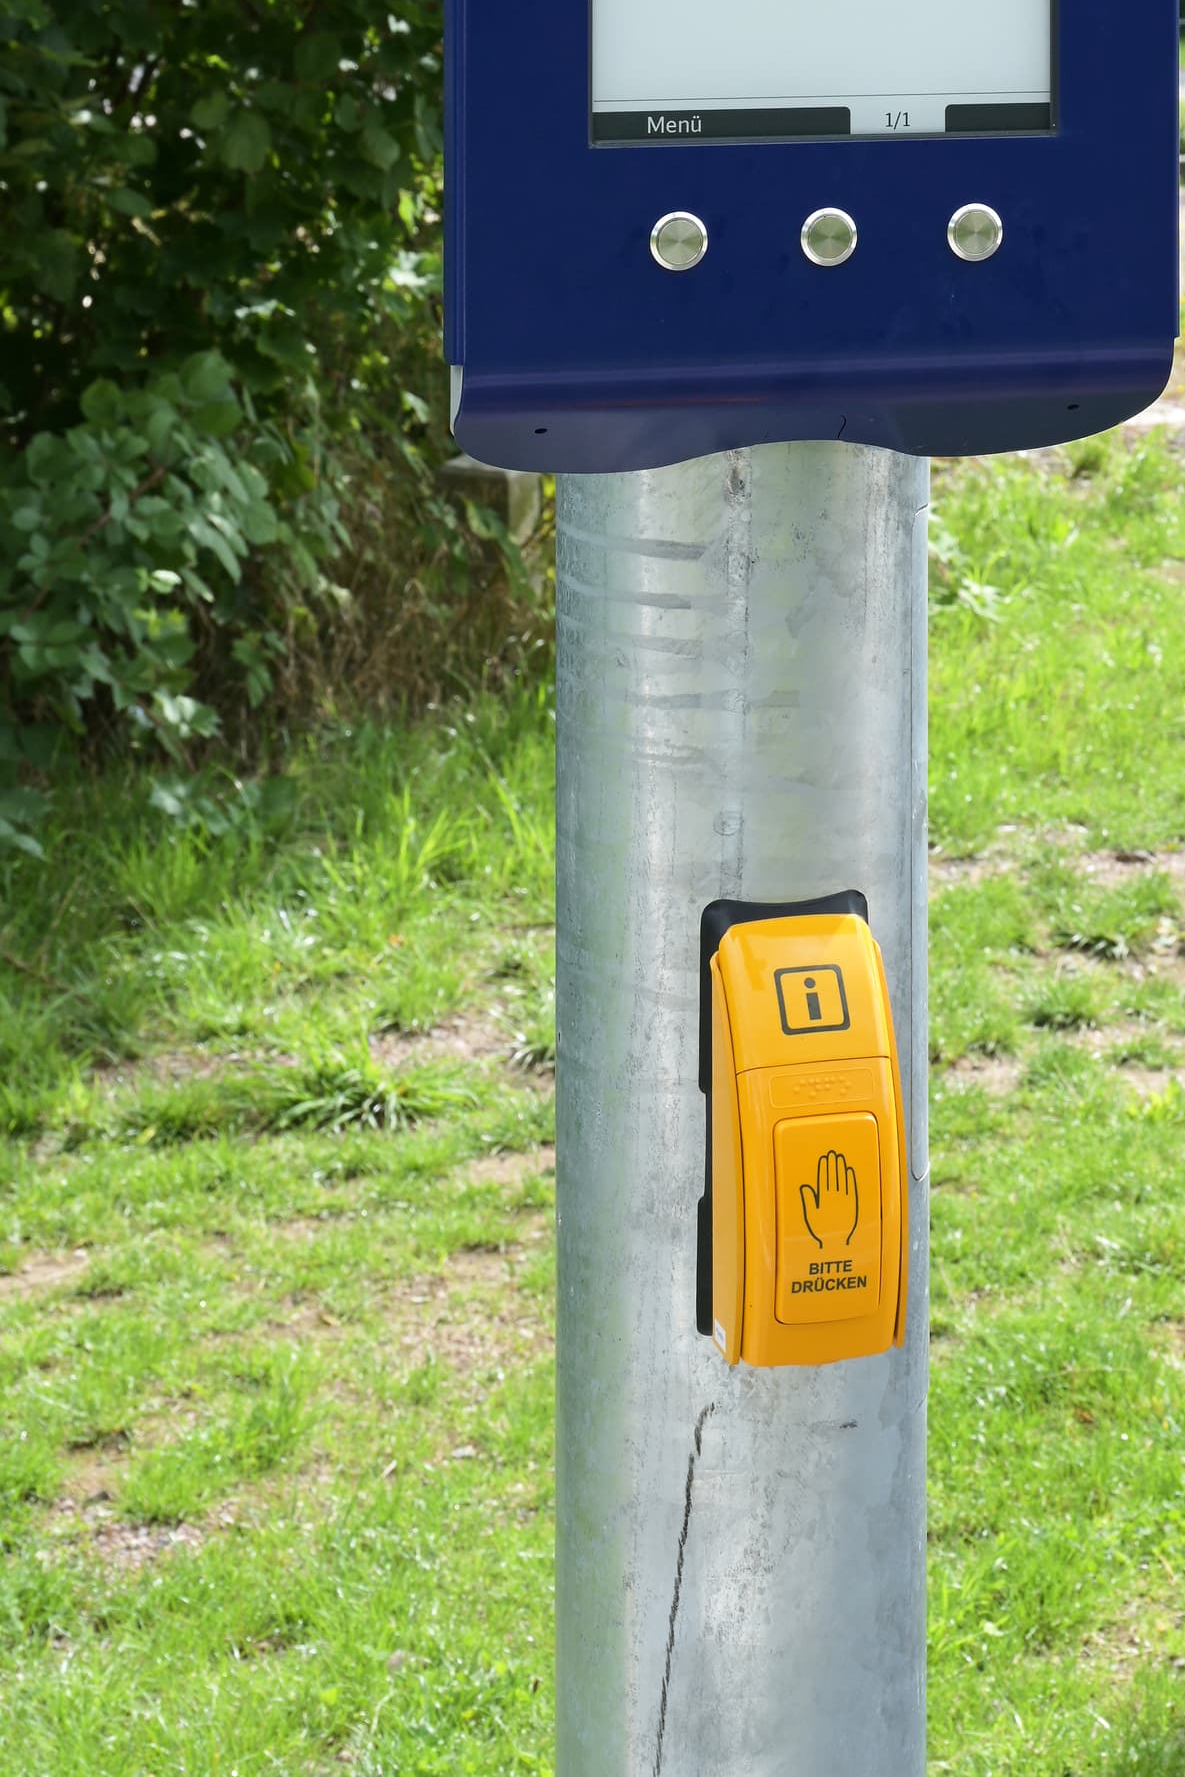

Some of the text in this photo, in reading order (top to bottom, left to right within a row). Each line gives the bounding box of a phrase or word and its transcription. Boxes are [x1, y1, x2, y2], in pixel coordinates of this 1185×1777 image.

[646, 110, 910, 134] Menü 1/1
[809, 1260, 852, 1275] BITTE
[791, 1275, 867, 1294] DRÜCKEN
